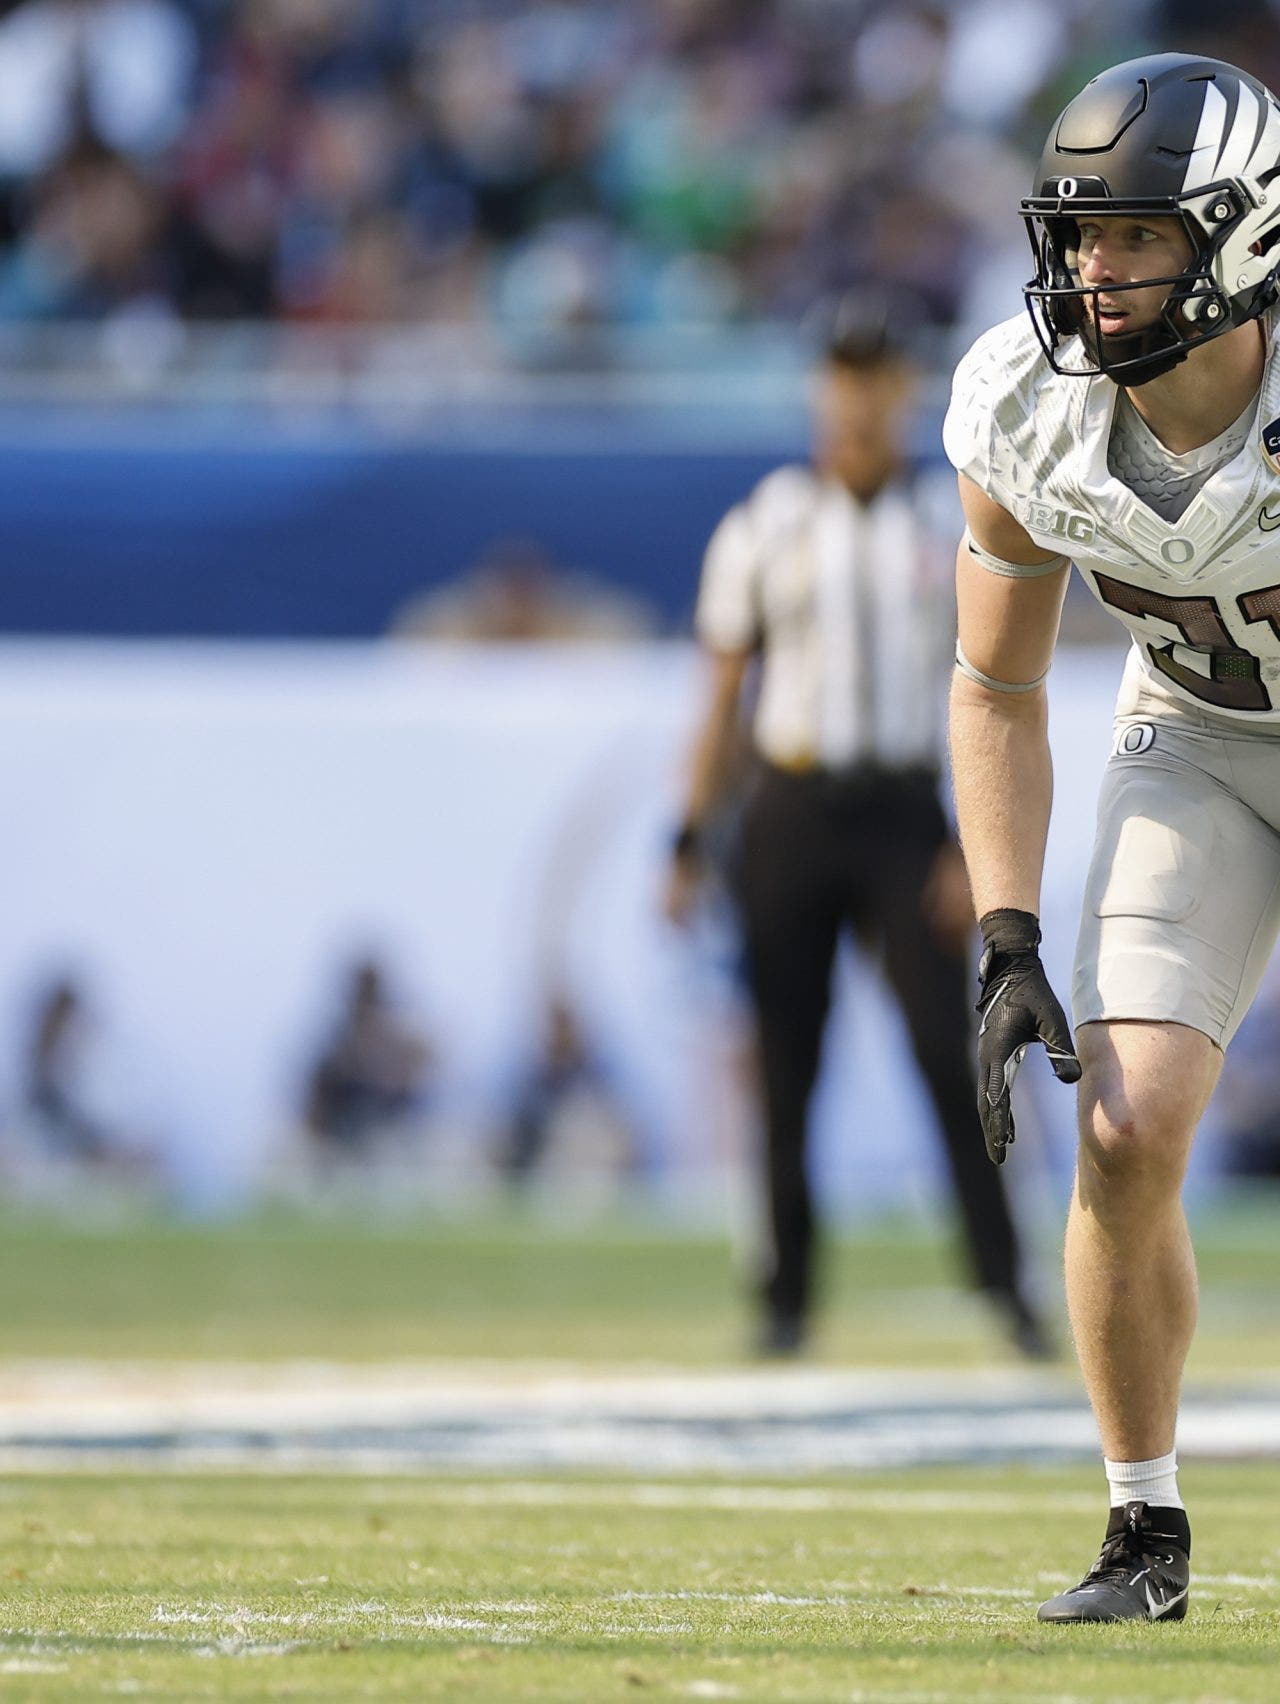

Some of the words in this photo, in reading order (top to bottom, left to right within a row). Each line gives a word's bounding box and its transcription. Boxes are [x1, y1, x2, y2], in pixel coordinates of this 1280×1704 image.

[1058, 178, 1078, 198] O
[1161, 538, 1195, 564] O
[1116, 721, 1156, 756] O
